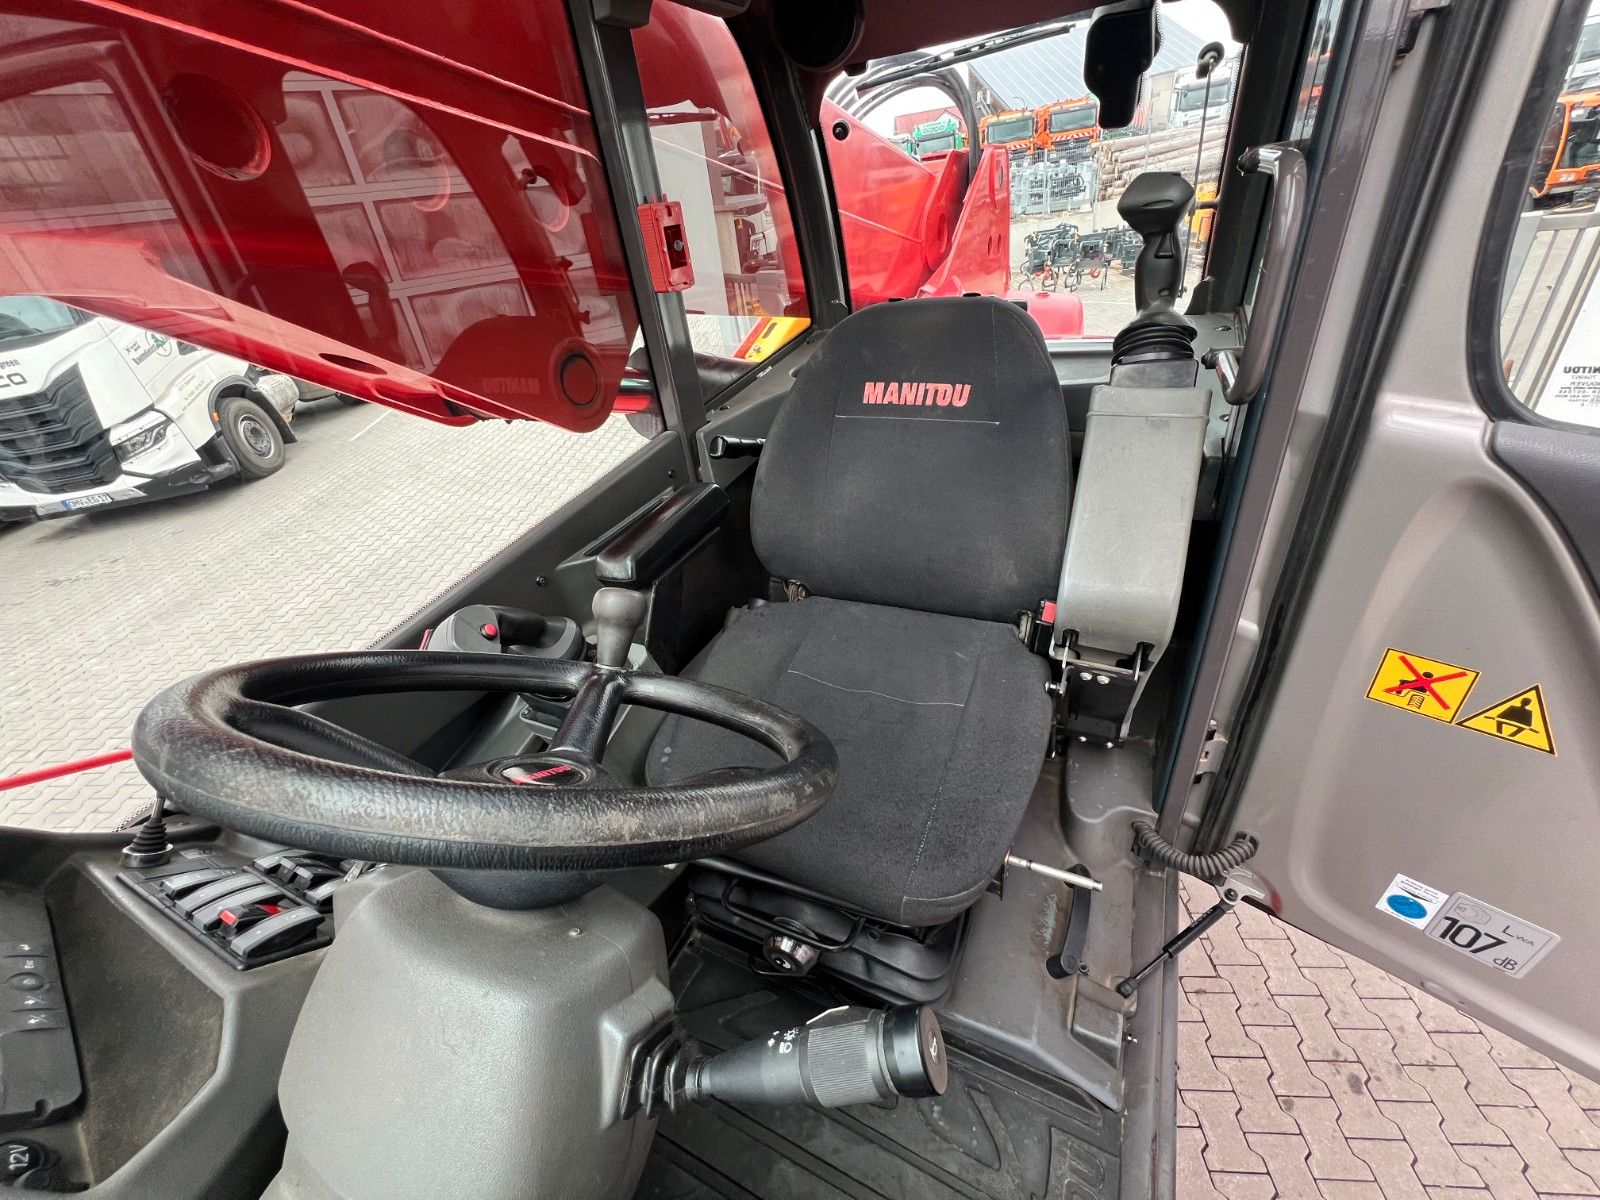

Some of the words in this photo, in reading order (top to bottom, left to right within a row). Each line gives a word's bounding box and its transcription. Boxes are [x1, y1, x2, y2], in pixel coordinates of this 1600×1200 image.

[863, 381, 971, 407] MANITOU
[1439, 916, 1507, 954] 107
[1493, 956, 1518, 971] dB
[8, 1144, 29, 1171] 12V
